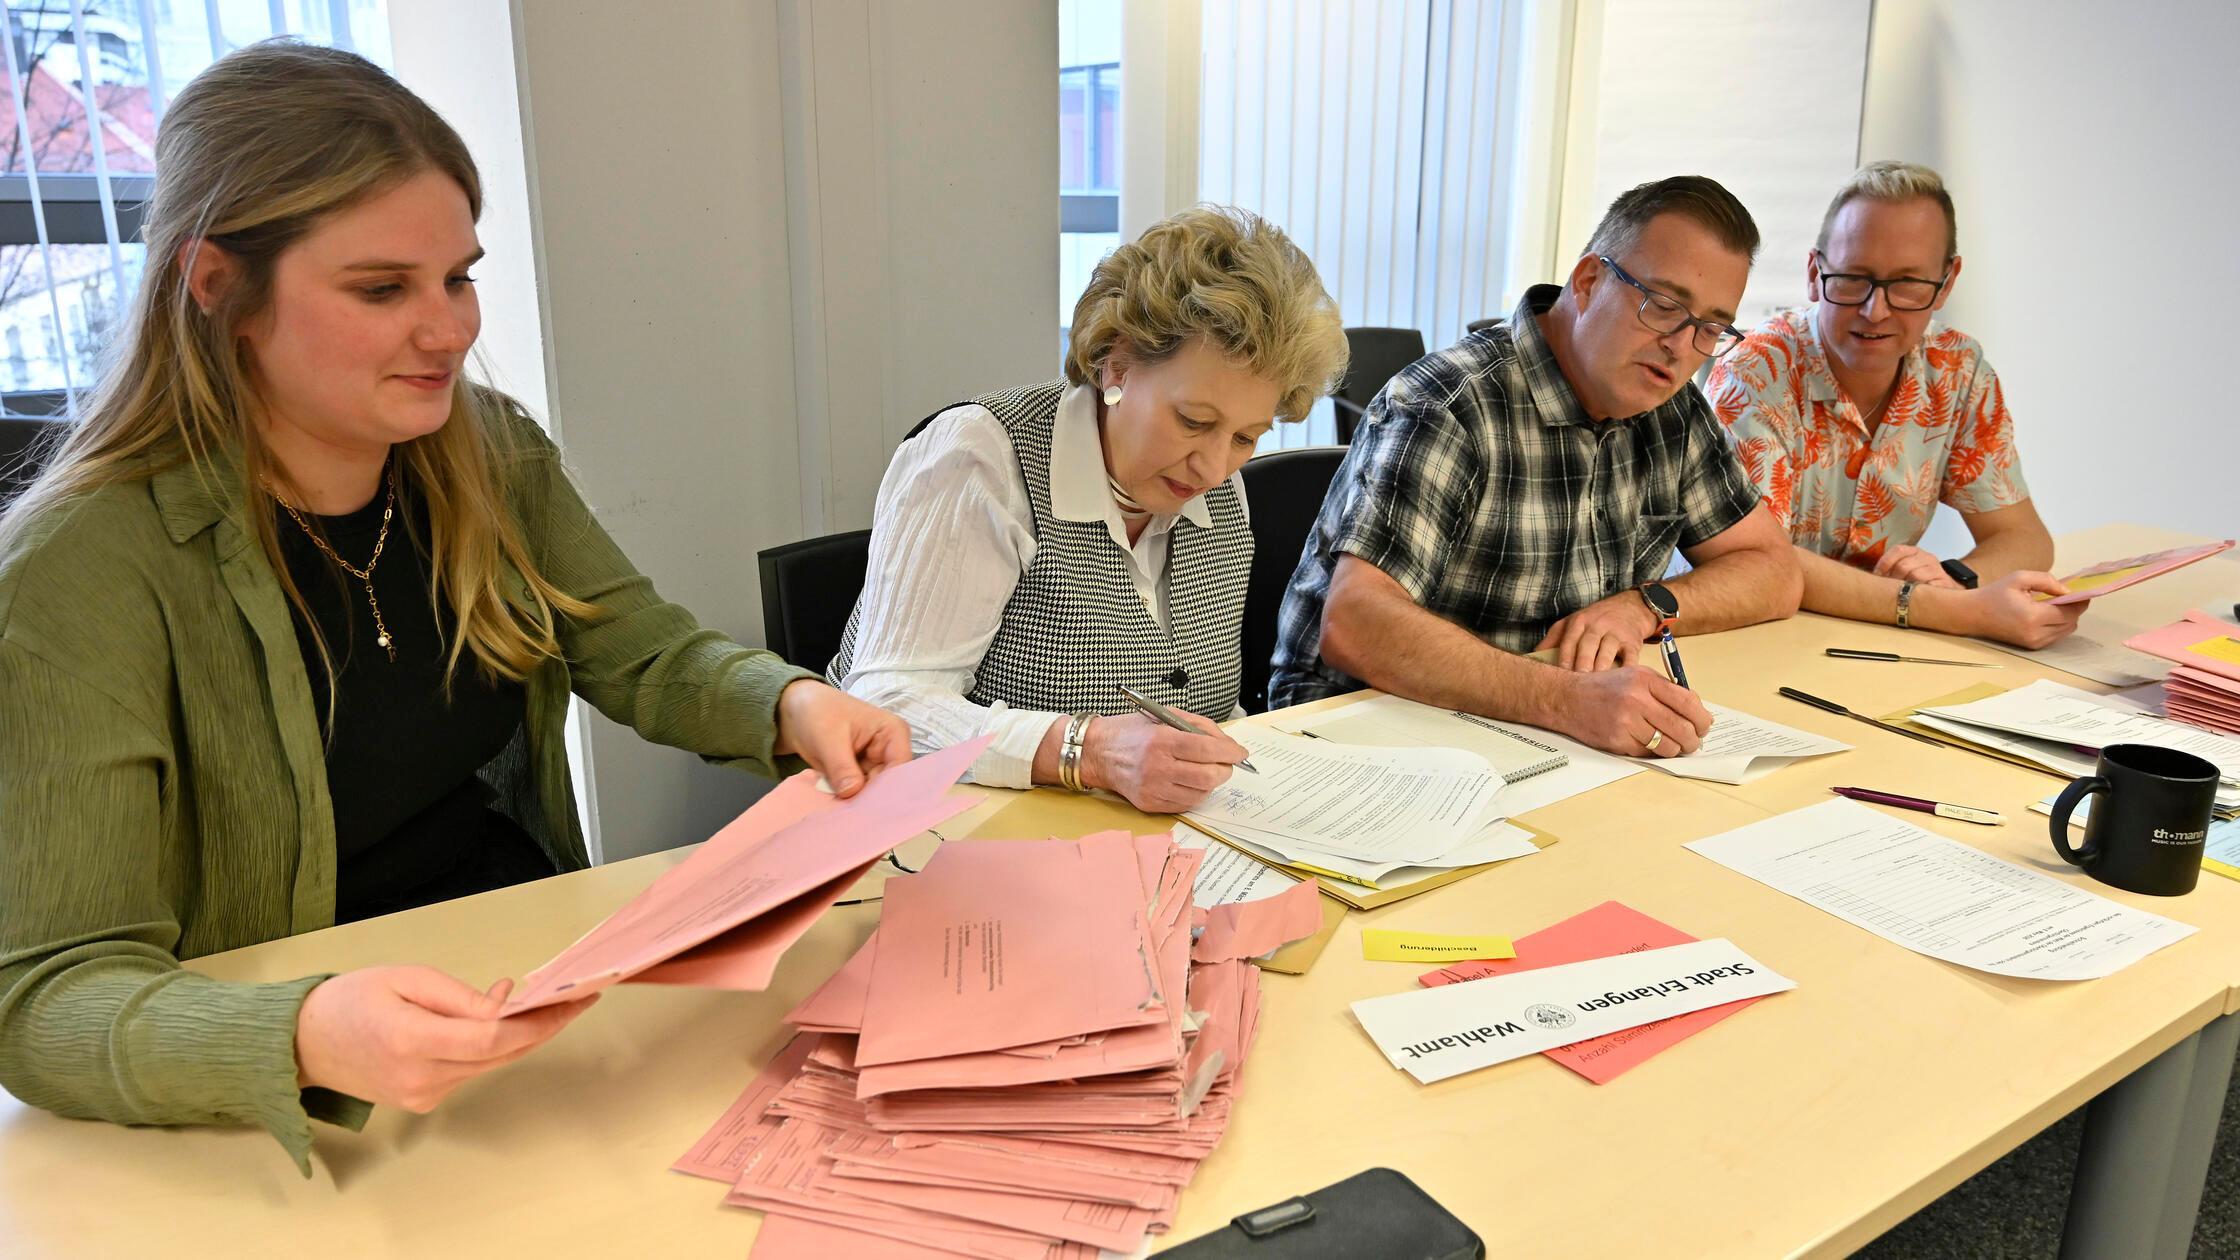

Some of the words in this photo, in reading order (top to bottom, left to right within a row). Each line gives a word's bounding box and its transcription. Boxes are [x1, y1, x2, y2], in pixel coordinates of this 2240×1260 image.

[1399, 943, 1478, 953] Beschilderung
[1684, 963, 1755, 986] Stadt
[1577, 979, 1690, 1013] Erlangen
[1401, 1020, 1525, 1059] Wahlamt
[1578, 1042, 1617, 1064] Anzahl
